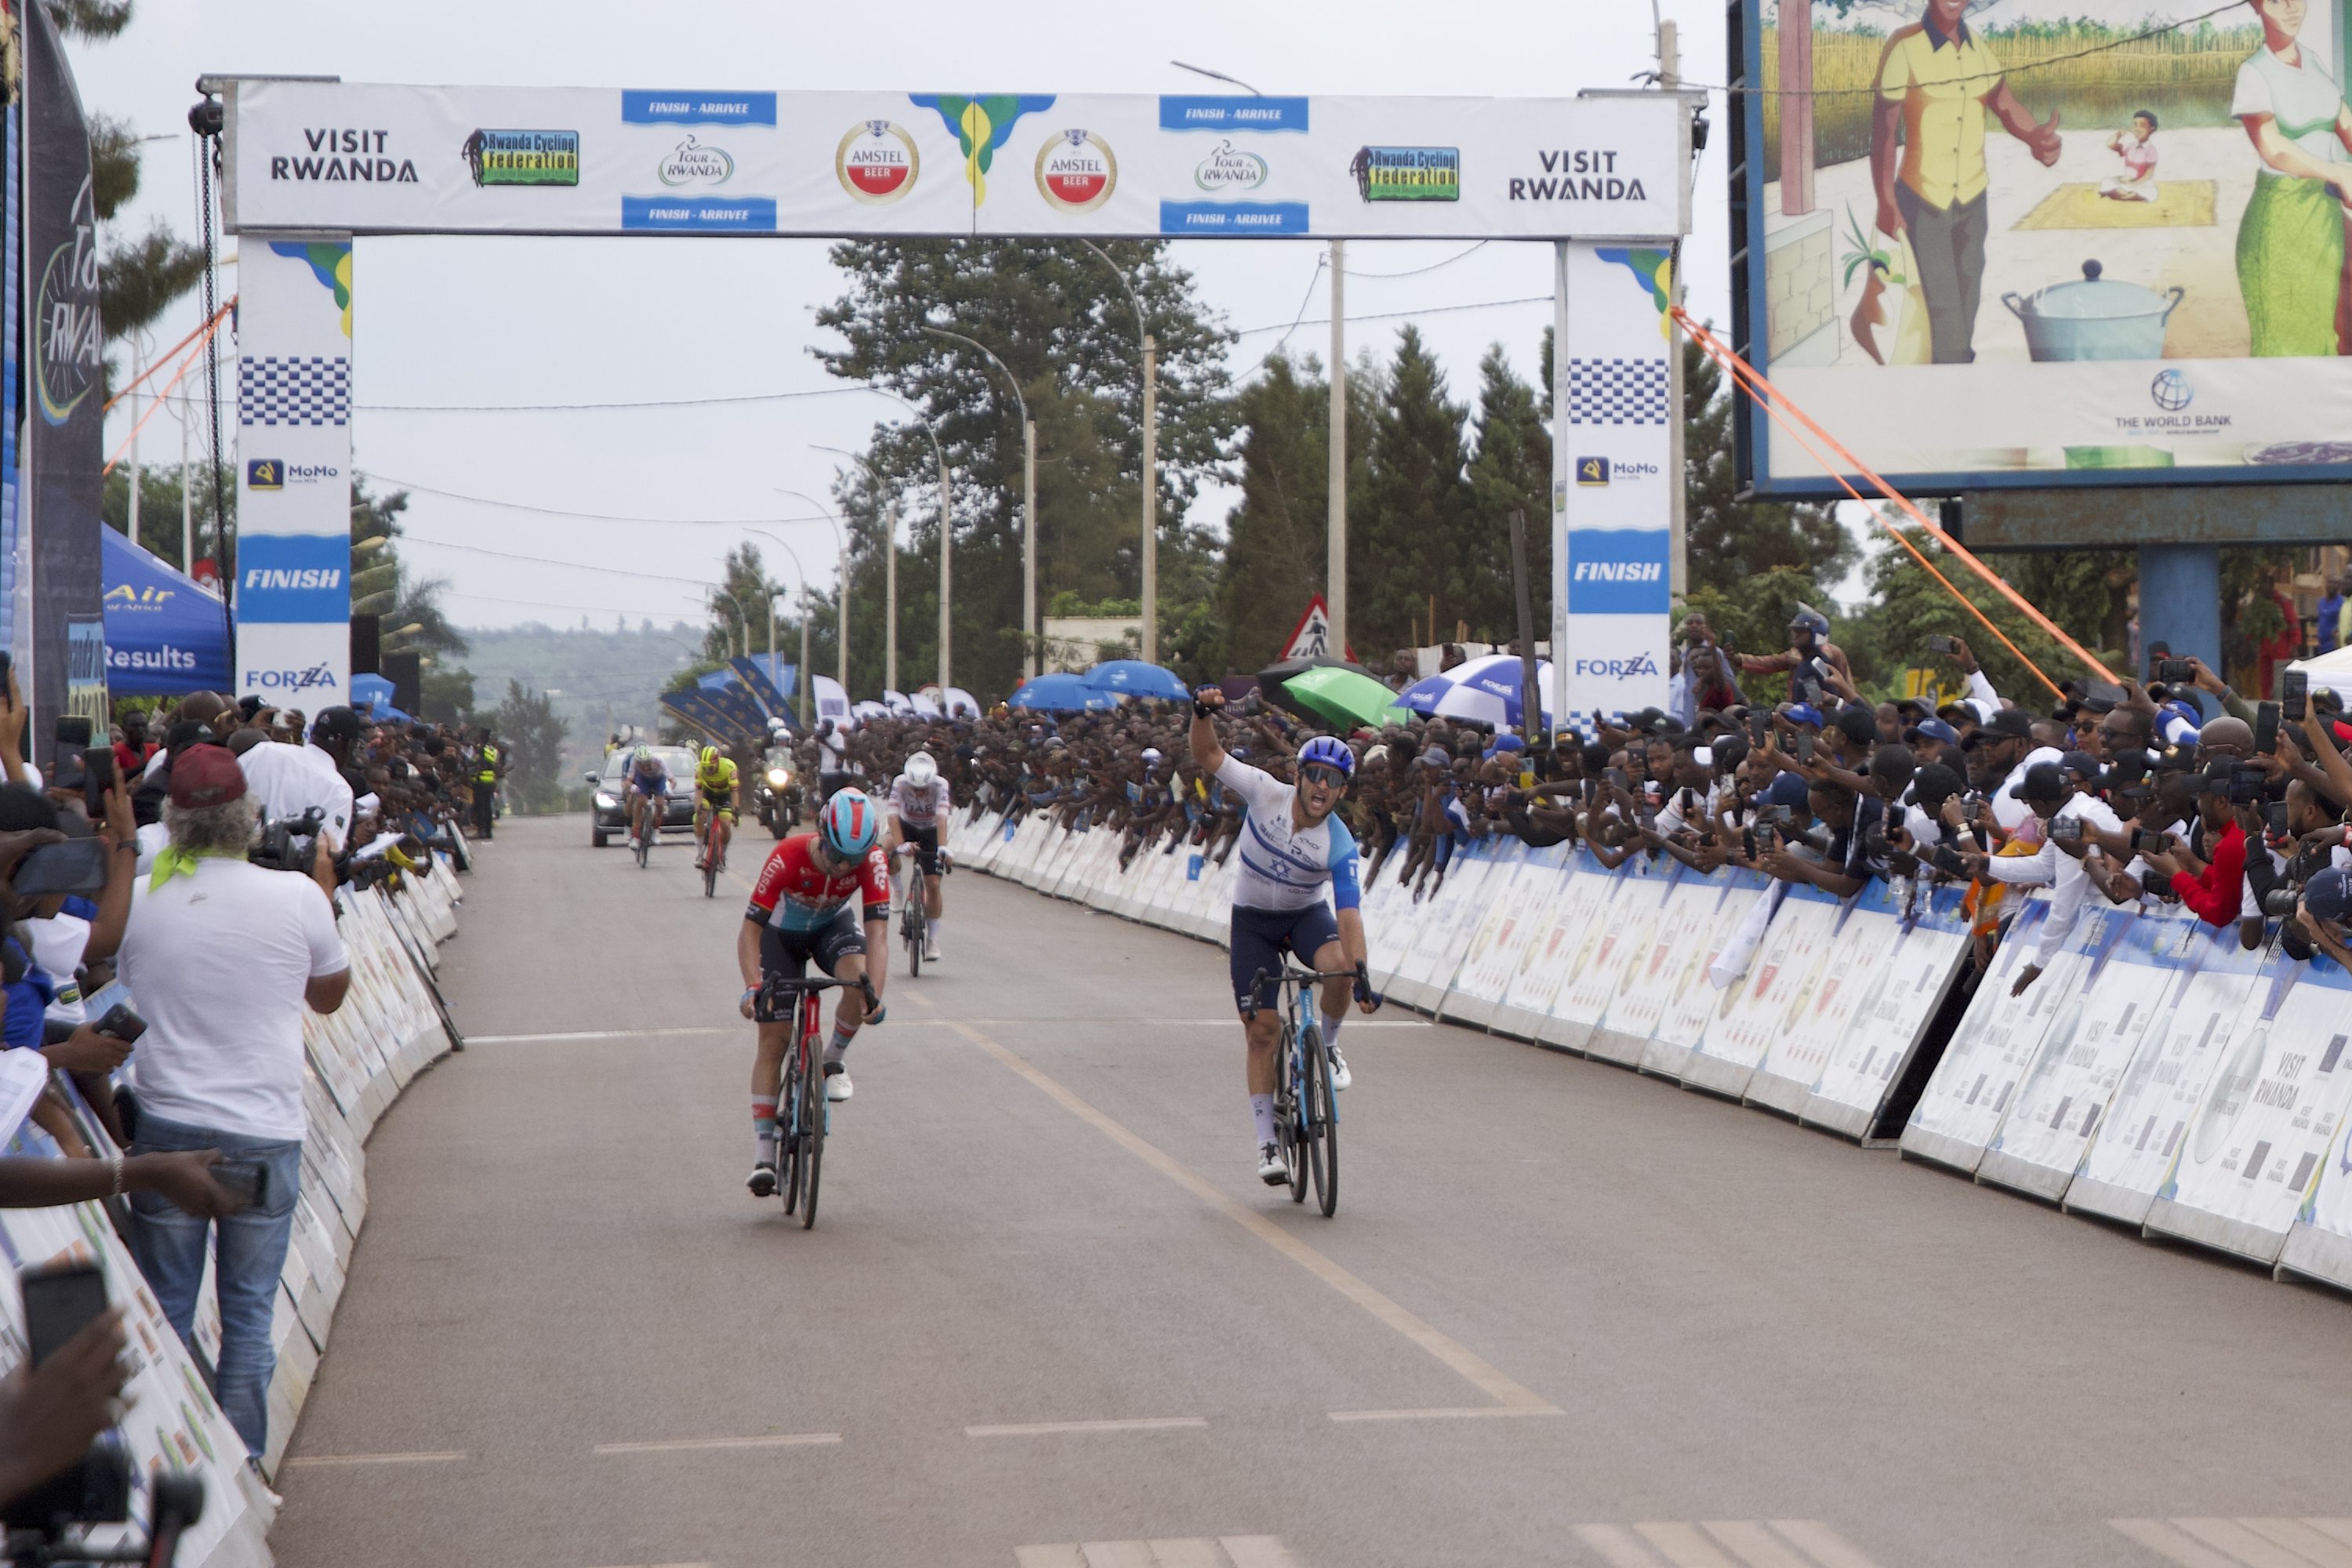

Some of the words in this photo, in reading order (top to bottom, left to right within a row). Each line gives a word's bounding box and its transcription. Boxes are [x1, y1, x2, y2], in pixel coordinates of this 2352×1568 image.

[648, 102, 690, 114] FINISH
[699, 103, 750, 114] ARRIVEE
[1185, 108, 1225, 119] FINISH
[1233, 108, 1282, 119] ARRIVEE
[304, 128, 388, 154] VISIT
[488, 133, 532, 150] Rwanda
[534, 135, 575, 154] Cycling
[488, 151, 575, 169] Federation
[852, 150, 904, 163] AMSTEL
[1375, 151, 1415, 167] Rwanda
[1417, 151, 1455, 169] Cycling
[1538, 150, 1617, 173] VISIT
[271, 156, 419, 183] RWANDA
[667, 165, 723, 176] RWANDA
[864, 167, 891, 178] BEER
[1051, 159, 1102, 172] AMSTEL
[1062, 176, 1089, 187] BEER
[1203, 169, 1257, 180] RWANDA
[1375, 168, 1455, 184] Federation
[1508, 177, 1646, 201] RWANDA
[648, 208, 690, 220] FINISH
[699, 209, 750, 220] ARRIVEE
[1186, 213, 1225, 224] FINISH
[1234, 213, 1283, 224] ARRIVEE
[2115, 416, 2140, 428] THE
[2144, 416, 2191, 427] WORLD
[2195, 415, 2232, 426] BANK
[289, 465, 338, 477] MoMo
[1613, 463, 1658, 474] MoMo
[1574, 561, 1661, 582] FINISH
[245, 568, 341, 590] FINISH
[105, 644, 196, 668] Results
[2277, 1051, 2307, 1080] VISIT
[2253, 1078, 2300, 1110] RWANDA
